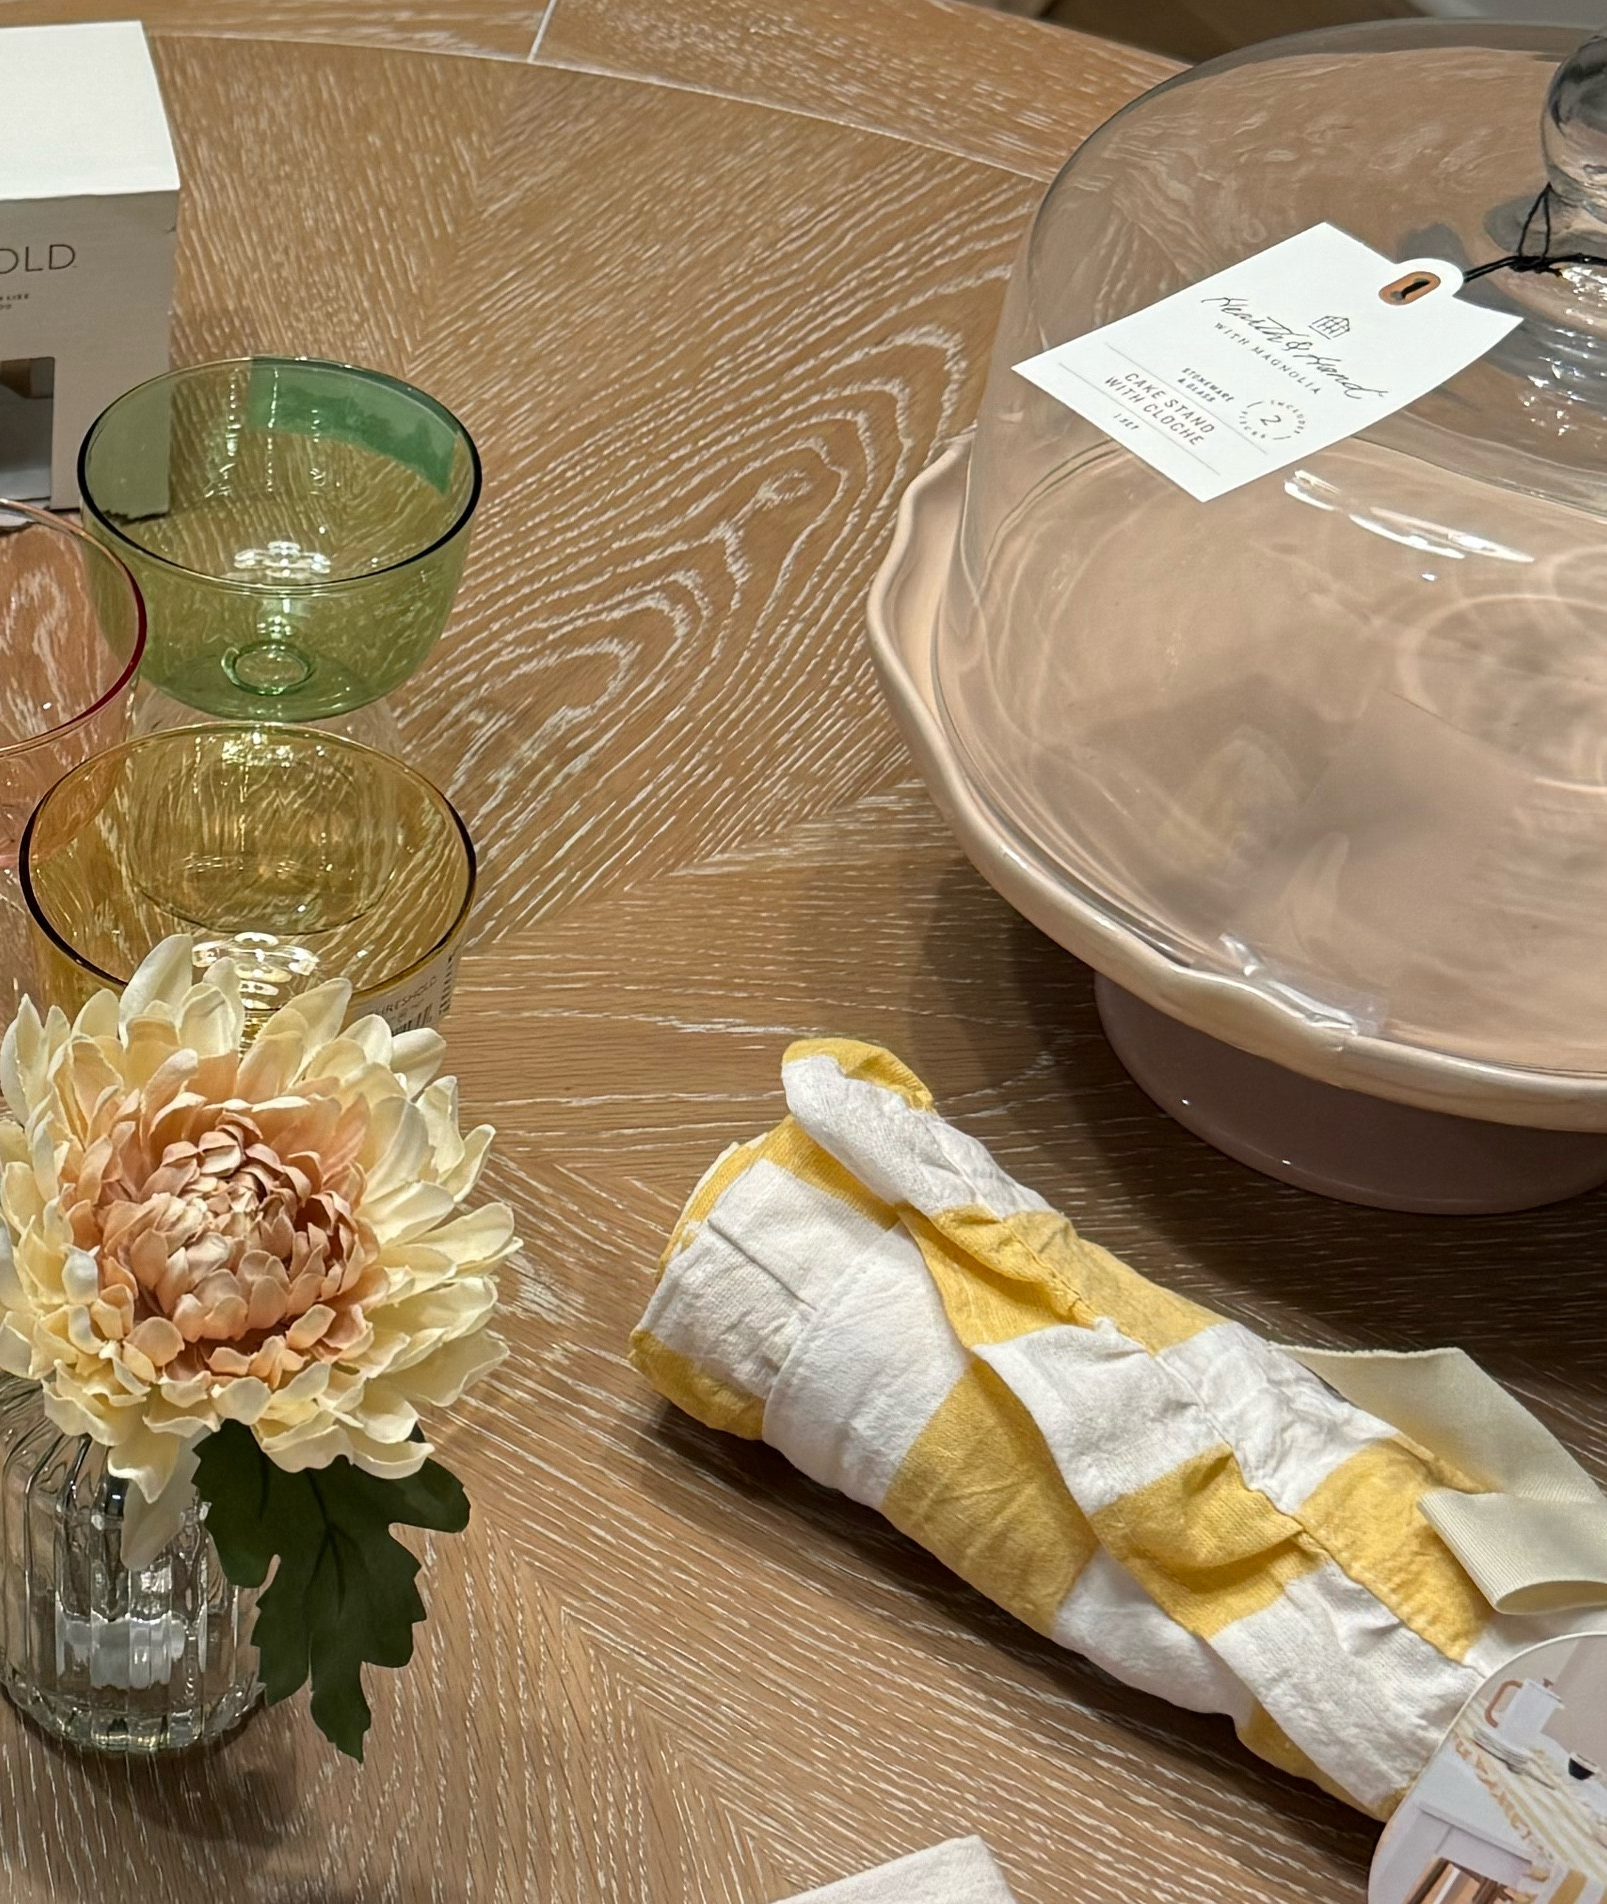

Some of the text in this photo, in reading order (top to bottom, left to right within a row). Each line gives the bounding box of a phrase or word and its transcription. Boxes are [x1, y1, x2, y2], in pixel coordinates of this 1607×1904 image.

[1201, 296, 1389, 400] Hearth & Hand
[1214, 321, 1322, 394] WITH MAGNOLIA
[1181, 367, 1235, 402] STONEWARE
[1184, 380, 1216, 402] GLASS
[1105, 375, 1204, 445] WITH CLOCHE
[1124, 372, 1216, 434] CAKE STAND
[1259, 414, 1282, 426] 2
[1270, 399, 1306, 434] INCLUDES
[1119, 416, 1140, 431] SET
